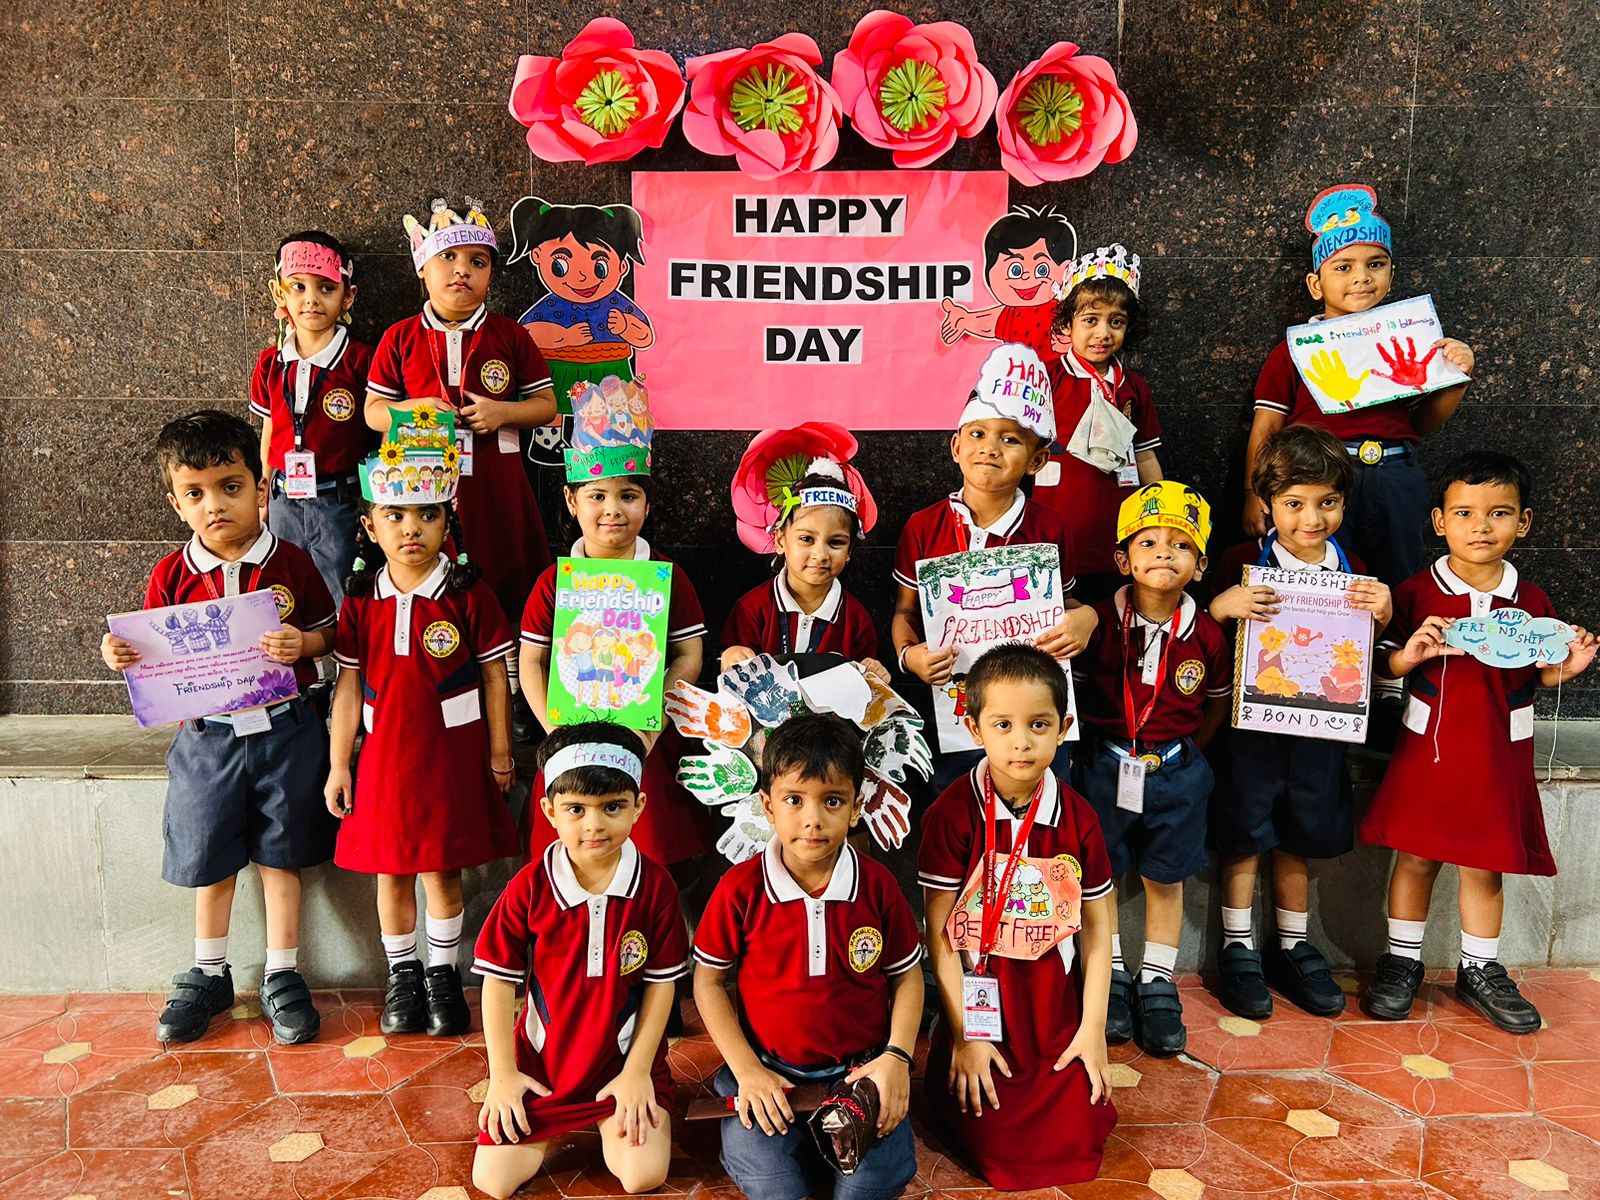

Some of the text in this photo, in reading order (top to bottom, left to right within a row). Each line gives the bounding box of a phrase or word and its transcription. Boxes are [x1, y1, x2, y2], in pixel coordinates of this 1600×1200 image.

[735, 197, 904, 234] HAPPY
[1314, 224, 1388, 271] FRIENDSHIP
[670, 262, 972, 301] FRIENDSHIP
[766, 328, 861, 362] DAY
[1023, 404, 1042, 424] DAY
[804, 490, 854, 508] FRIENDS
[572, 574, 636, 592] Happy
[1262, 572, 1347, 590] FRIENDSHI
[558, 589, 665, 616] Friendship
[965, 591, 1000, 606] HAPPY
[1296, 596, 1342, 608] FRIENDSHIP
[603, 608, 642, 630] Day
[940, 606, 1064, 647] FRIENDSHIP
[1492, 610, 1534, 626] HAPPY
[1528, 648, 1555, 661] DAY
[1262, 708, 1318, 727] BOND
[954, 911, 1059, 948] BET FRIE
